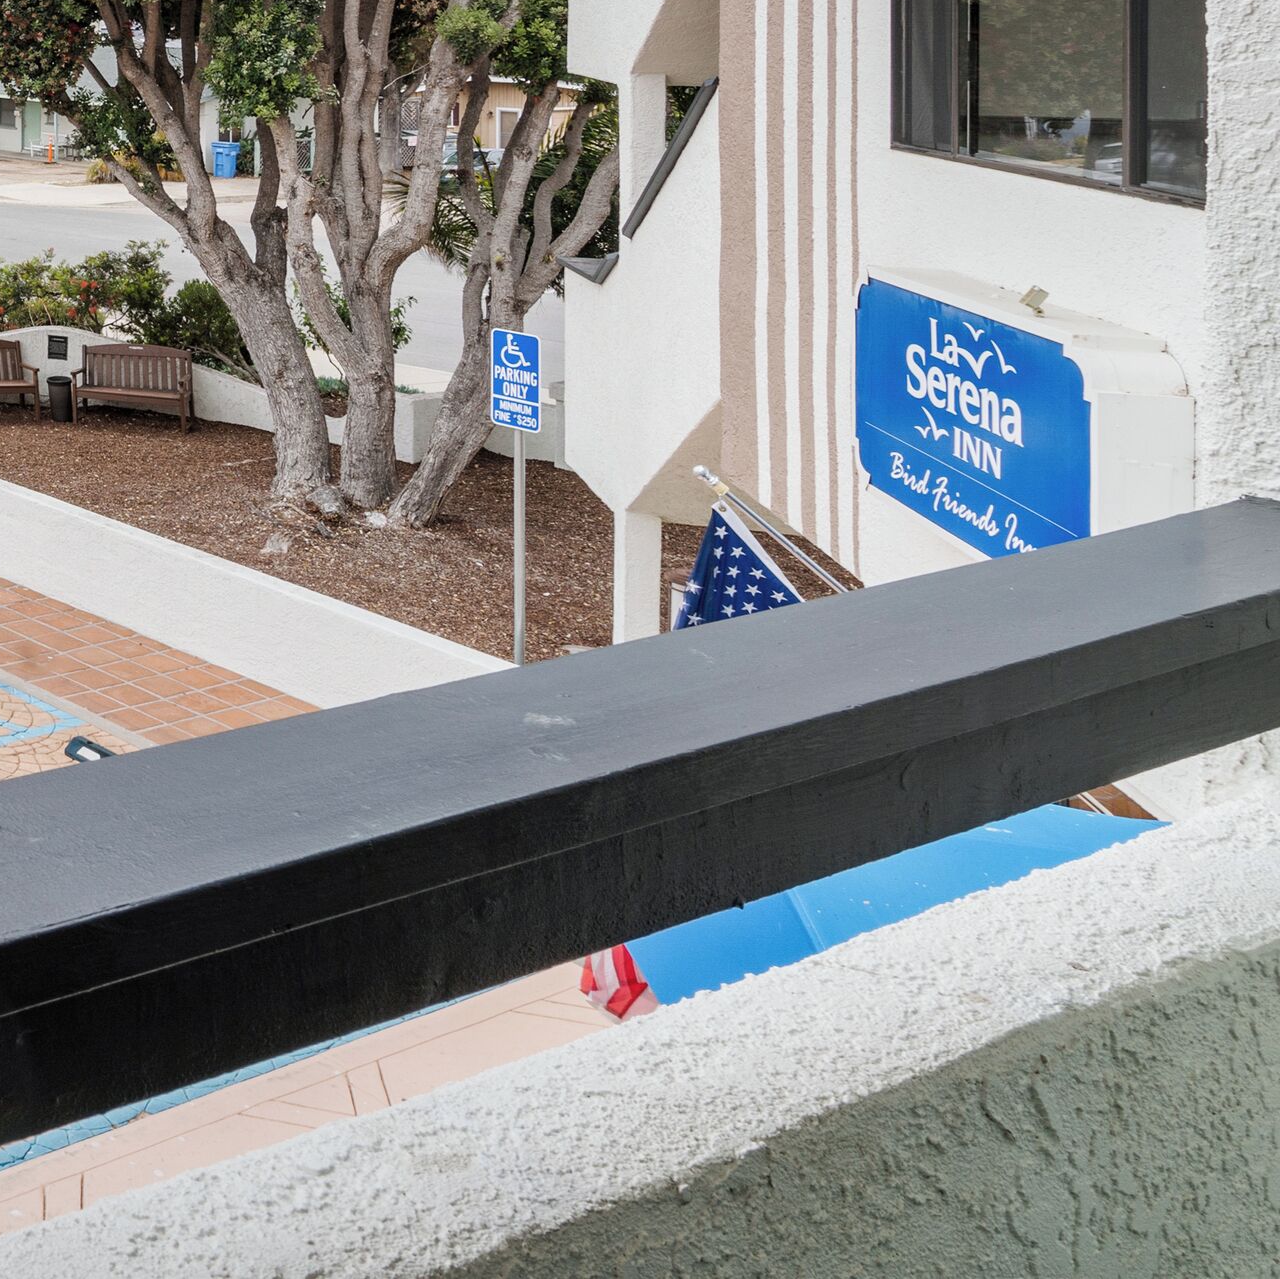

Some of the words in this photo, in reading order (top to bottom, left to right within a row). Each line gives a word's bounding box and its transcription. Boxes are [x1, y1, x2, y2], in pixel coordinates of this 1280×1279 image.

[929, 317, 960, 367] La
[494, 365, 537, 387] PARKING
[503, 381, 528, 399] ONLY
[499, 400, 532, 416] MINIMUM
[906, 344, 1024, 447] Serena
[495, 410, 512, 422] FINE
[953, 426, 1002, 480] INN
[890, 452, 930, 494] Bird
[932, 476, 999, 536] Friends
